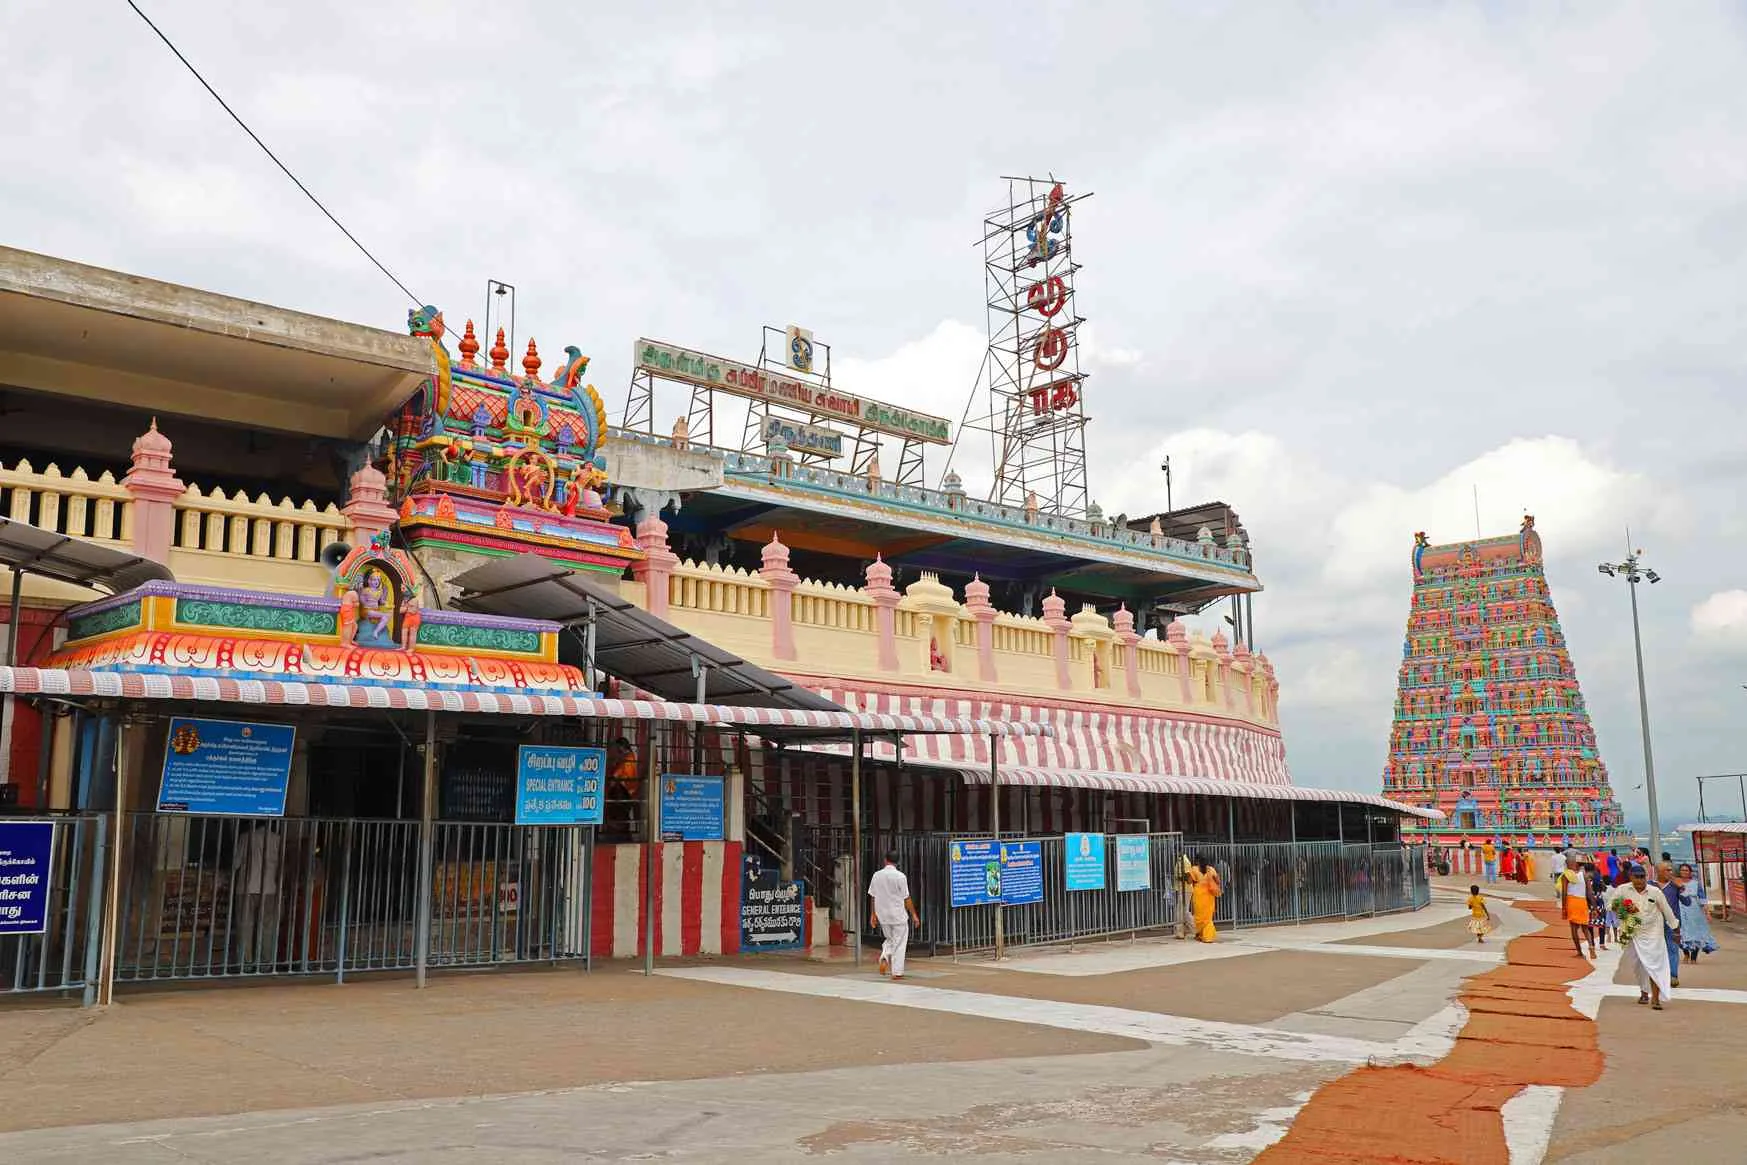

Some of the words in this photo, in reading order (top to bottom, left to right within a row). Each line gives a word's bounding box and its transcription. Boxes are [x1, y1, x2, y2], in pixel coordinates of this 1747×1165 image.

[526, 777, 547, 792] SPECIAL
[547, 778, 574, 792] ENTRANCE
[0, 874, 39, 885] களின்
[742, 905, 770, 915] GENERAL
[771, 905, 800, 914] ENTRANCE
